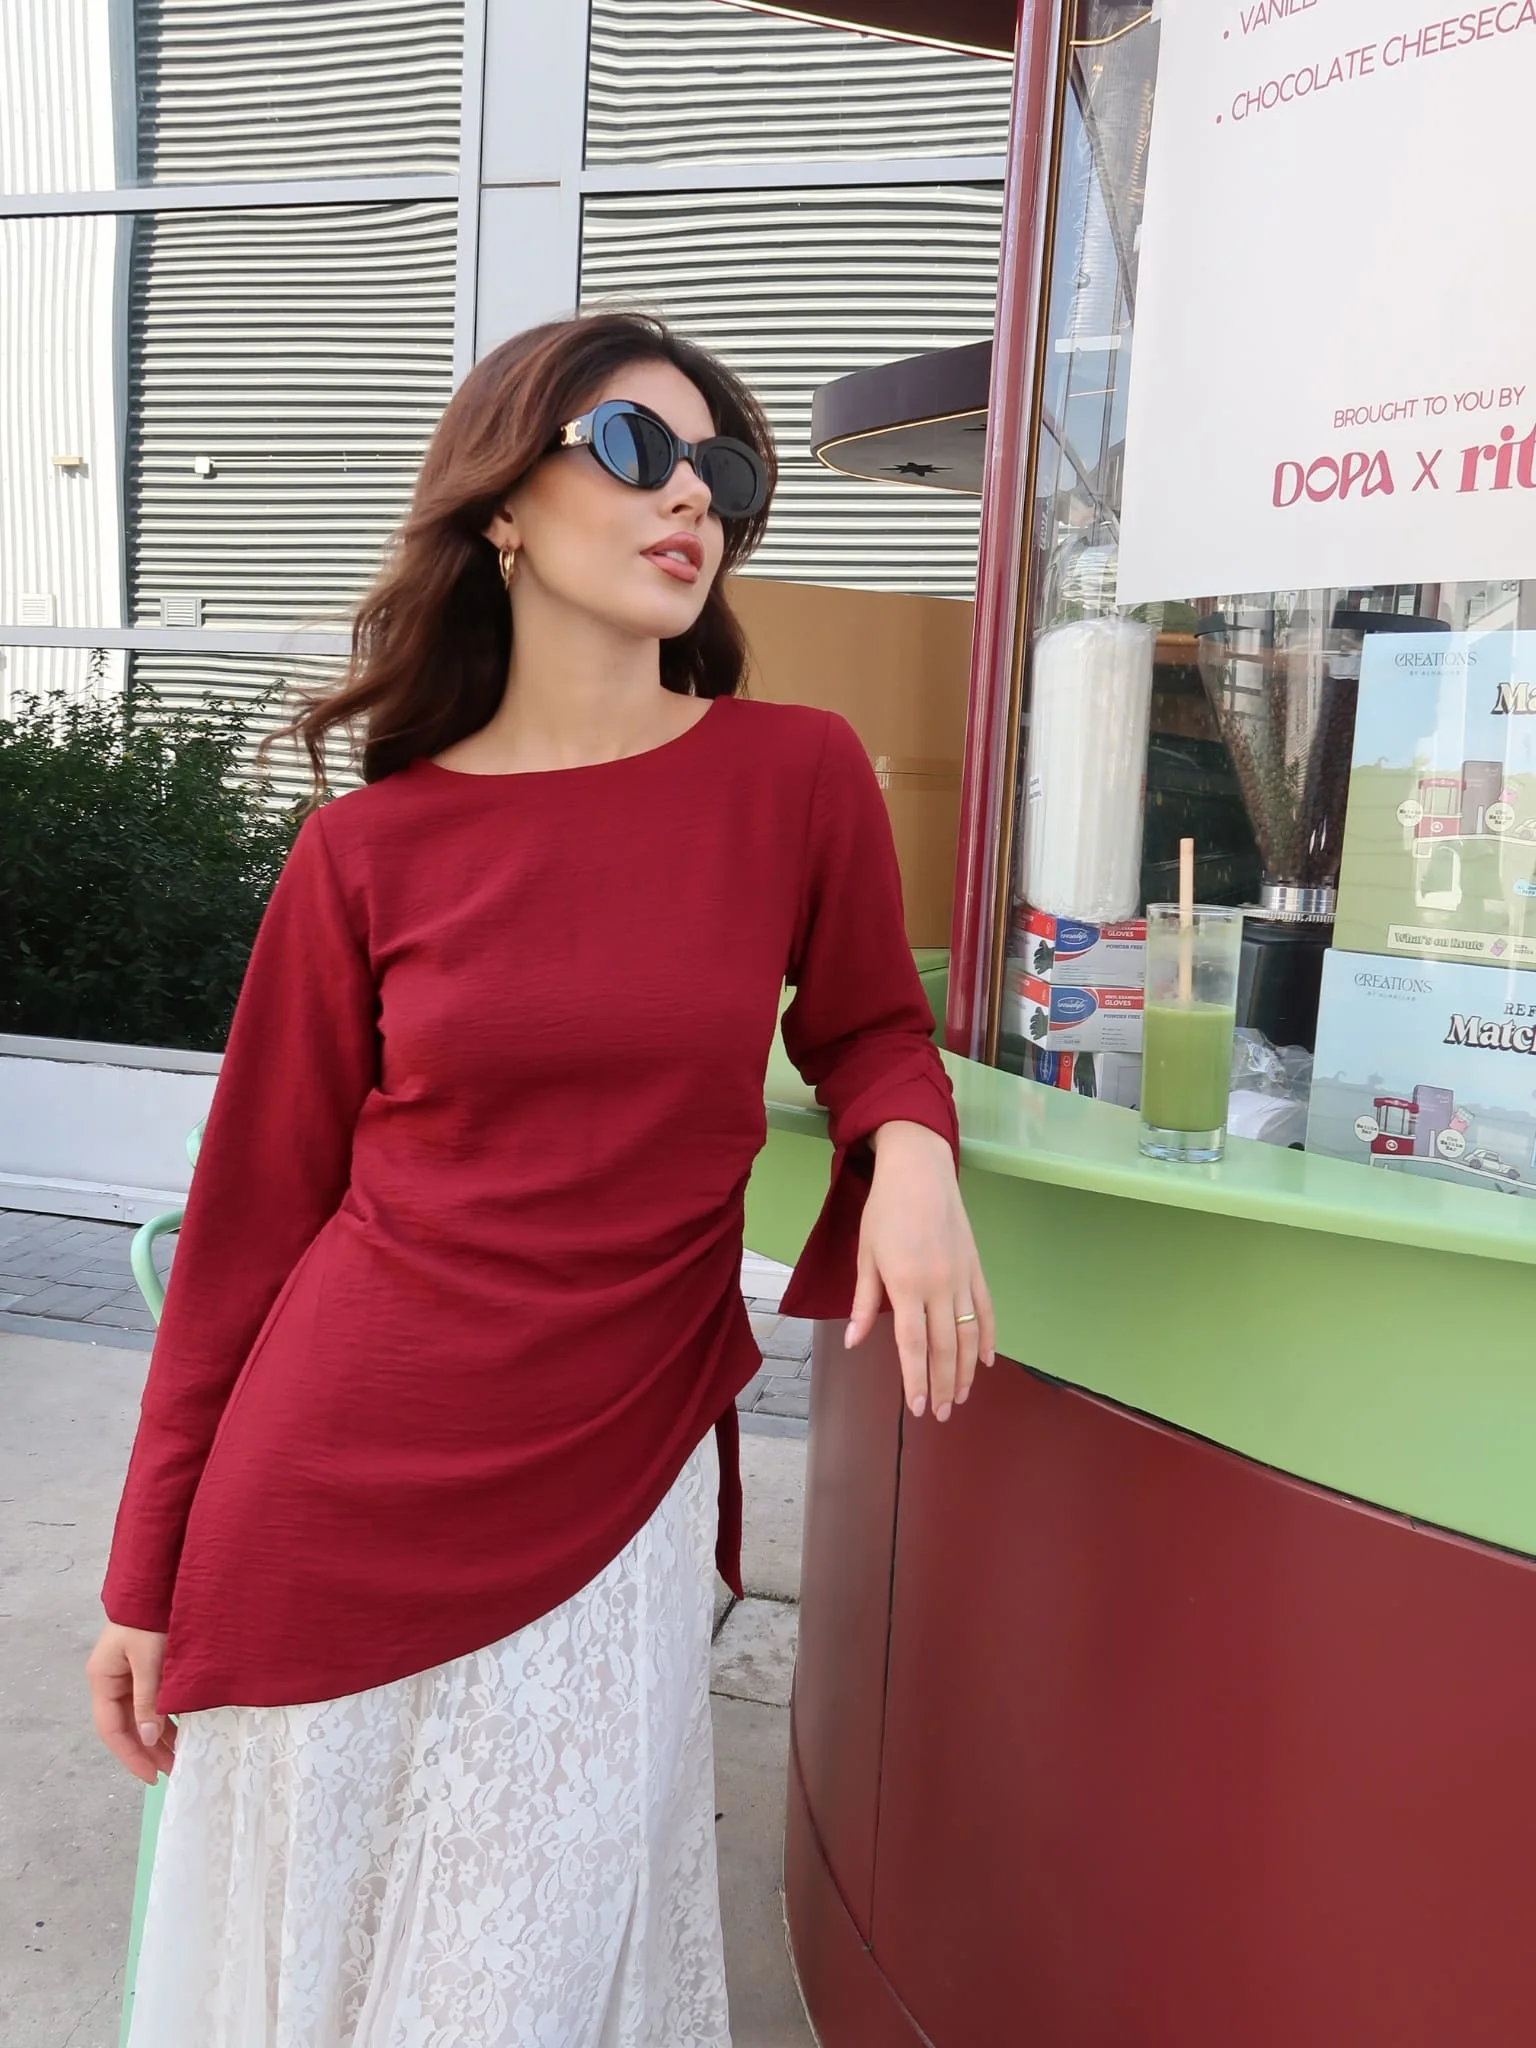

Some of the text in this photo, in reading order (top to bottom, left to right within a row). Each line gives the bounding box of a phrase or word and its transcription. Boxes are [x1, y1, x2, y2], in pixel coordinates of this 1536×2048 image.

[1231, 0, 1536, 121] CHOCOLATE CHEESECA
[1333, 385, 1526, 428] BROUGHT TO YOU BY
[1272, 449, 1395, 508] DOPA
[1394, 651, 1478, 667] CREATIONS
[1354, 972, 1433, 994] CREATIONS
[1503, 1002, 1536, 1017] REF
